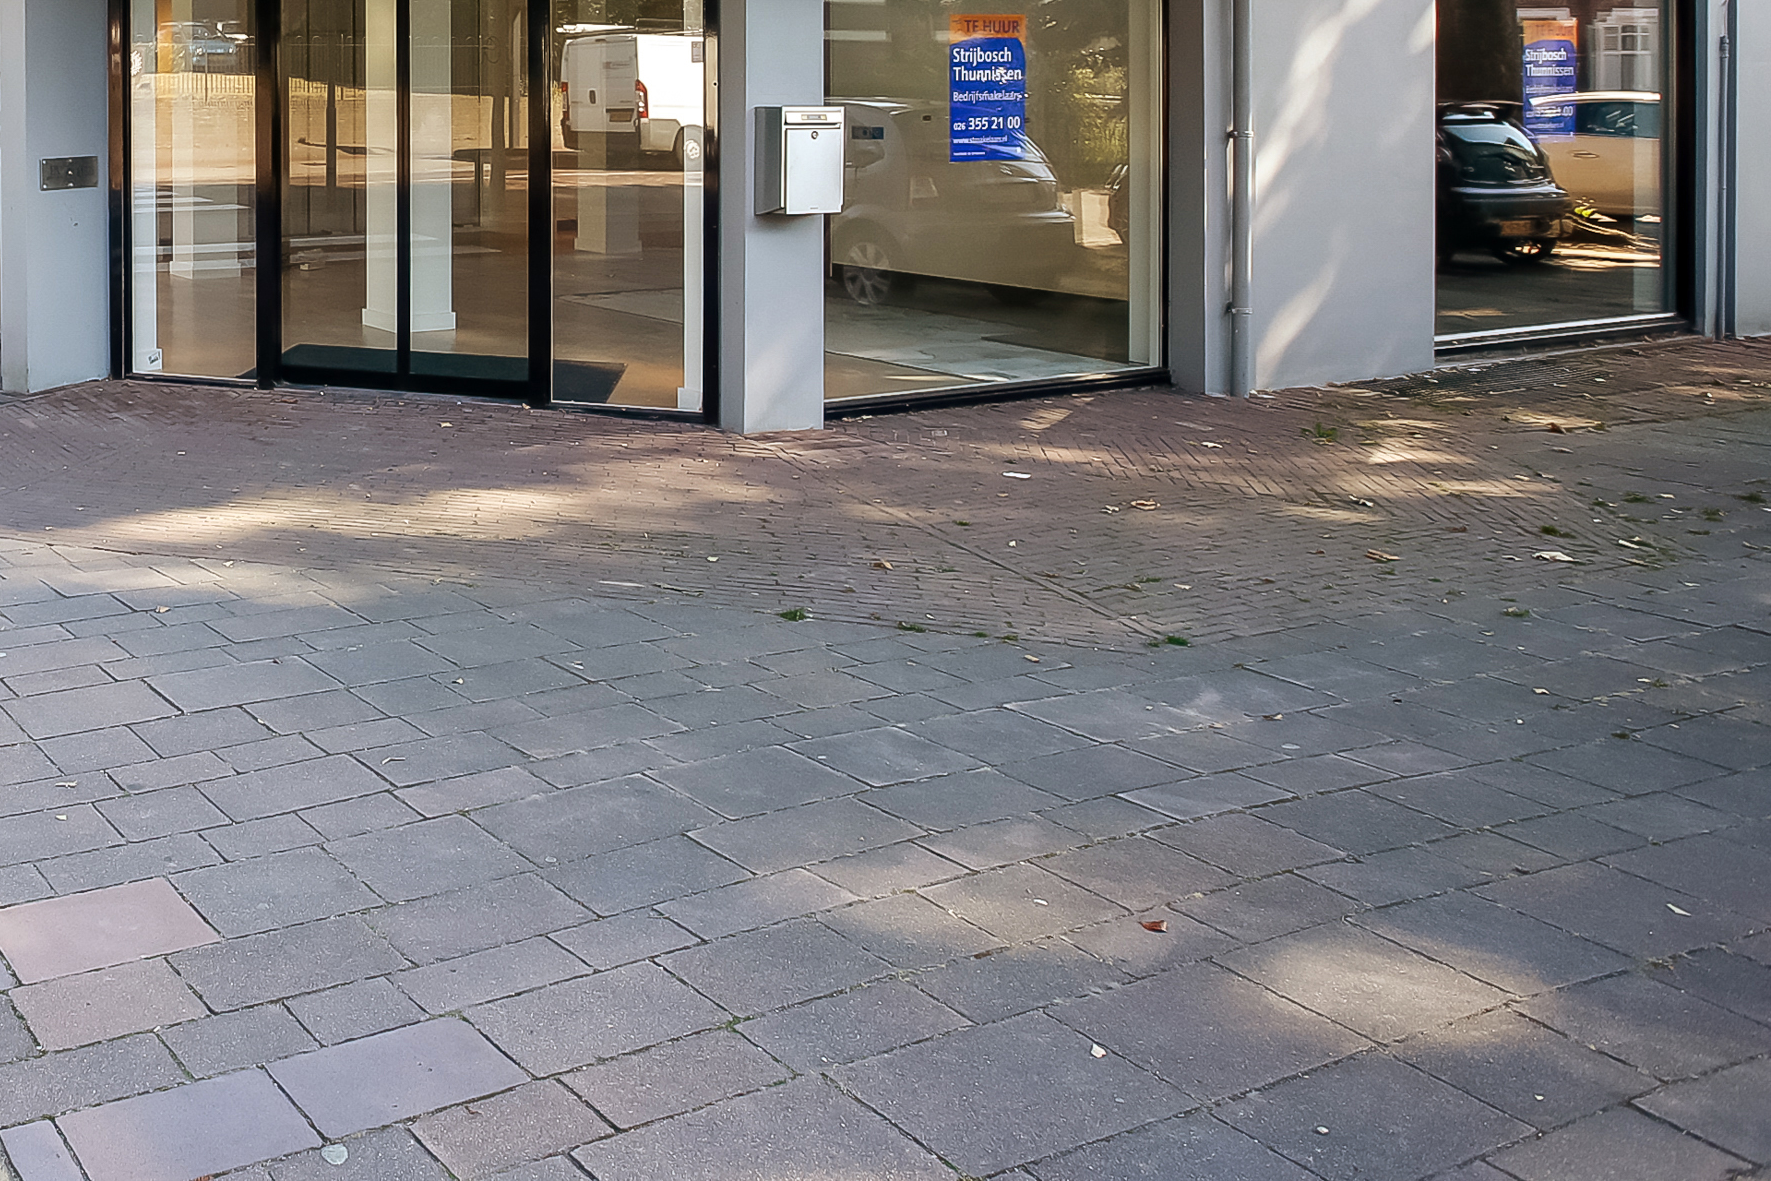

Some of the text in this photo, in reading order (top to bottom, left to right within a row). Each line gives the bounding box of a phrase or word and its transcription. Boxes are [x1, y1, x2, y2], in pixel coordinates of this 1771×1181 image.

[964, 20, 1020, 33] TE HUUR
[953, 47, 1012, 67] Strijbosch
[953, 66, 1022, 81] Thunnissen
[953, 115, 1021, 130] 026 355 21 00
